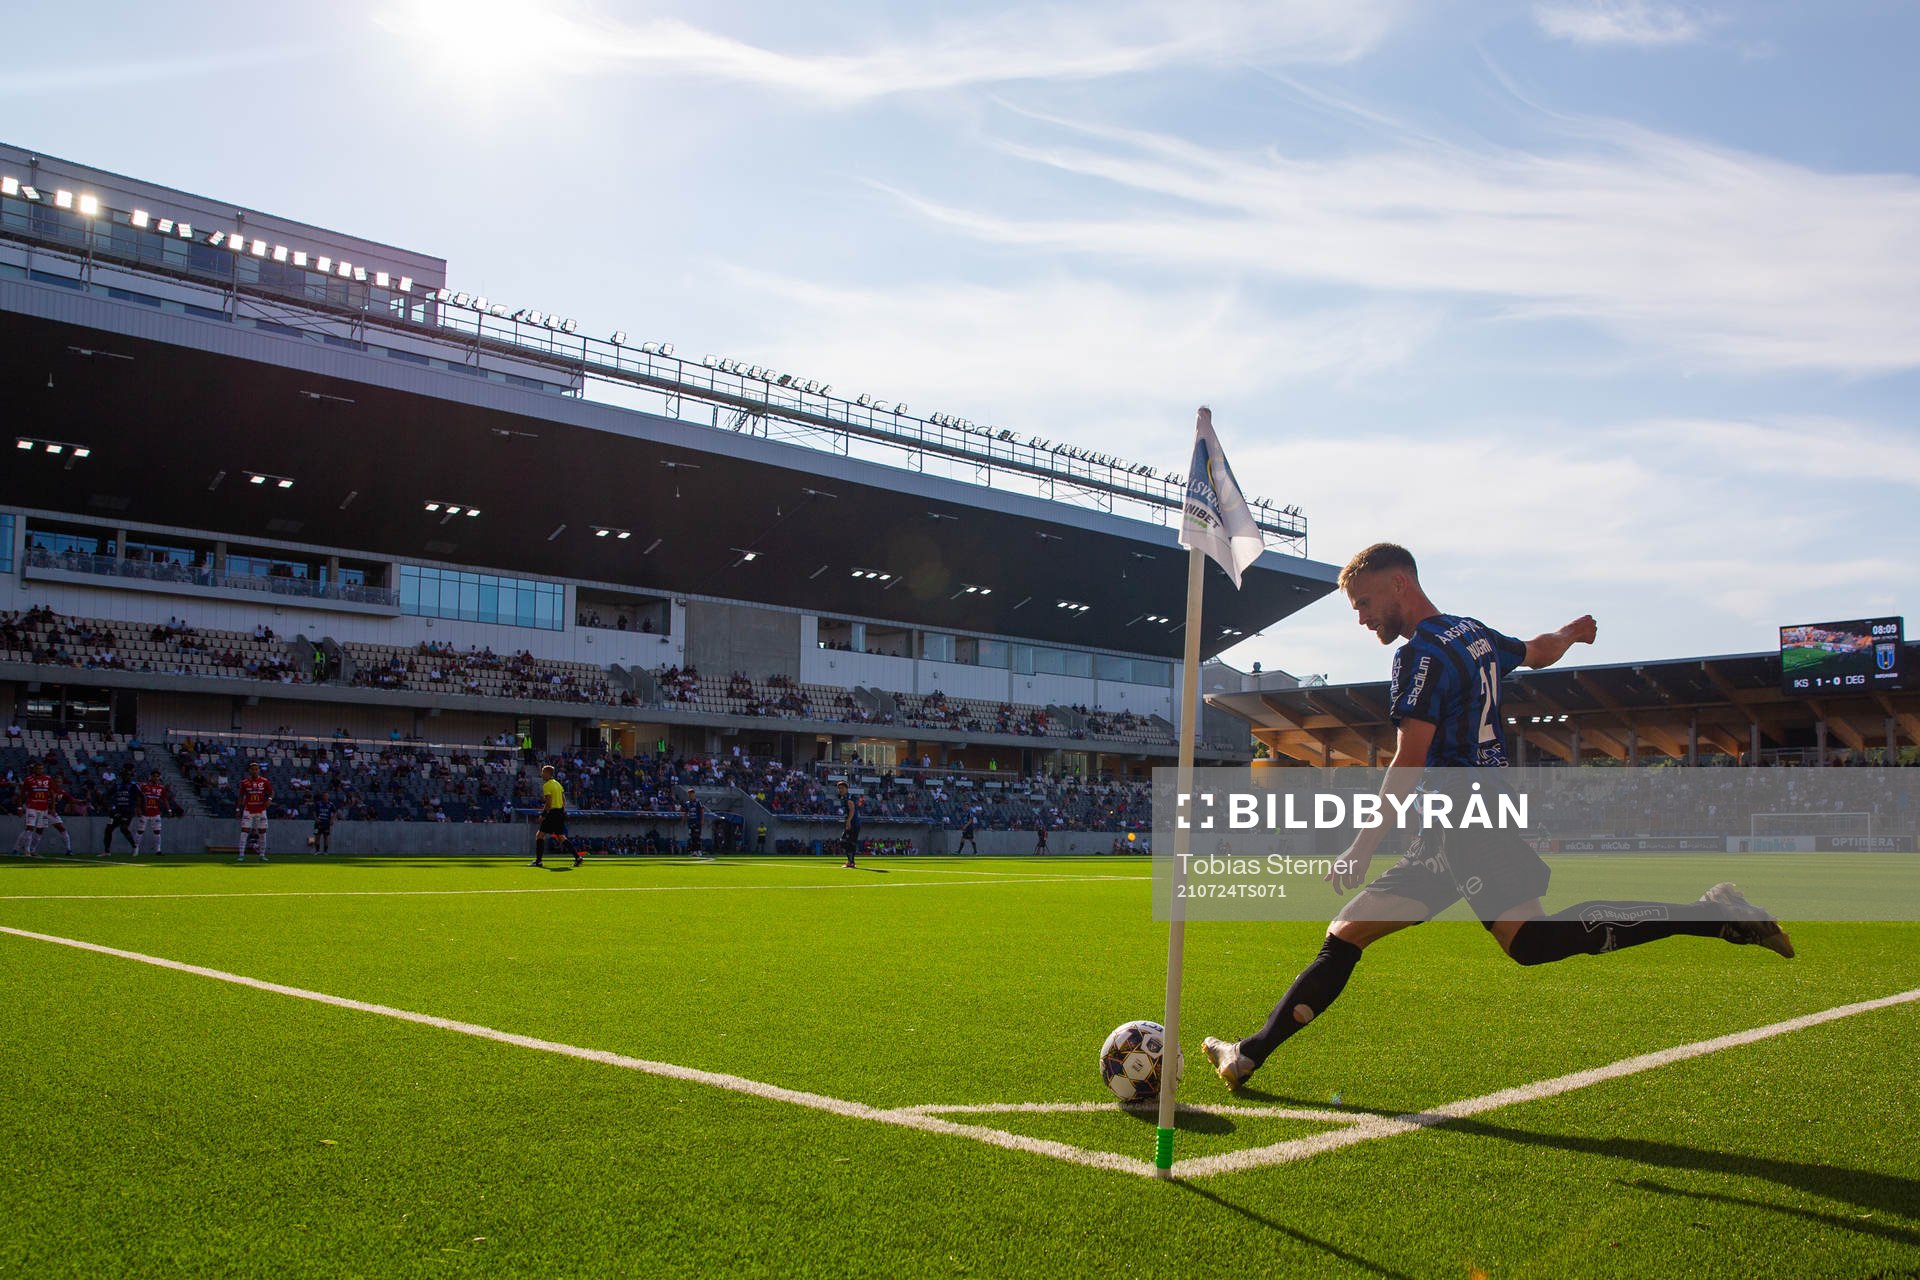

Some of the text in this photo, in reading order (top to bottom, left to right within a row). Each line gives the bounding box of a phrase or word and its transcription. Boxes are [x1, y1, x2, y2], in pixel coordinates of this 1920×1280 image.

[1184, 503, 1220, 528] NIBET
[1408, 656, 1431, 705] stadium
[1816, 678, 1823, 687] 1
[1833, 677, 1841, 686] 0
[1845, 675, 1865, 685] DEG
[1478, 661, 1498, 744] 21
[1831, 837, 1895, 847] OPTIMERA
[1603, 908, 1661, 921] Lundqvist
